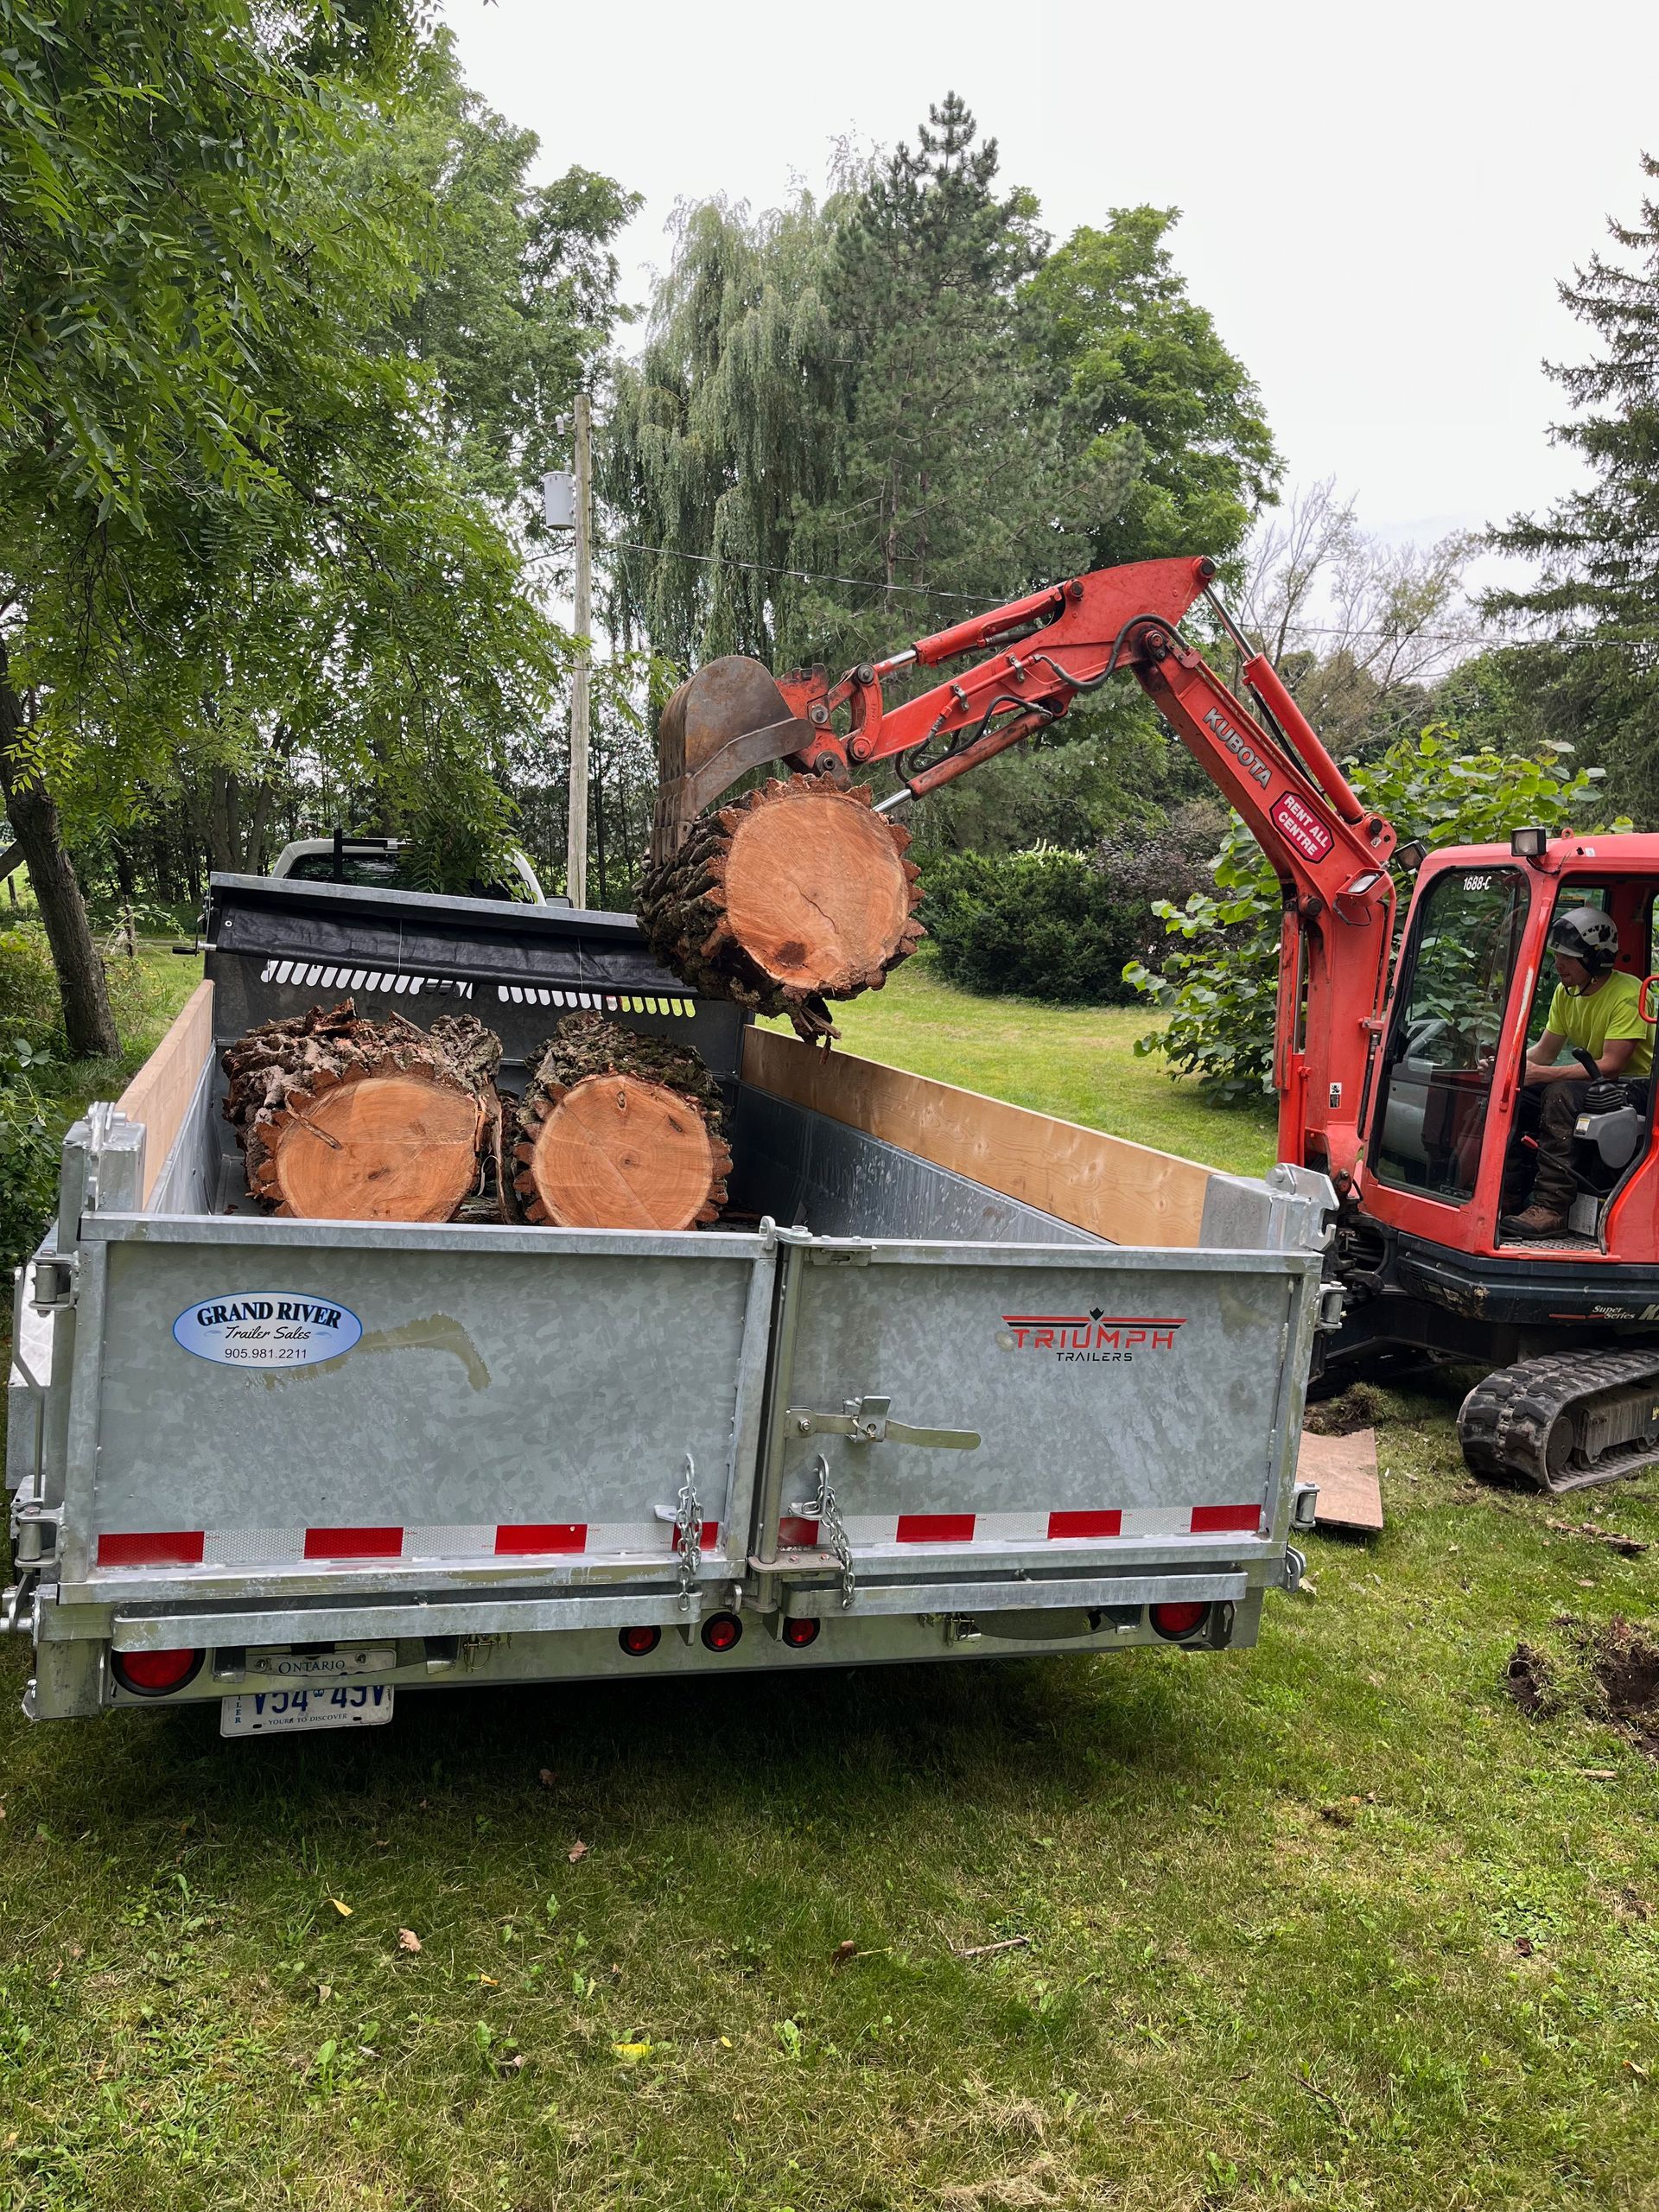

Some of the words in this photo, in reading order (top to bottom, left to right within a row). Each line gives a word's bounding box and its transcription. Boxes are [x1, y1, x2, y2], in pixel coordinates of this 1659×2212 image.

[1202, 706, 1273, 790] KUBOTA
[1283, 795, 1313, 827] RENT
[1308, 825, 1331, 849] ALL
[1278, 811, 1319, 856] CENTRE
[1463, 875, 1492, 891] 1688-C
[197, 1301, 273, 1327] GRAND
[276, 1301, 342, 1329] RIVER
[1592, 1305, 1624, 1314] Super
[1637, 1304, 1659, 1320] K
[225, 1325, 270, 1339] Trailer
[273, 1326, 311, 1339] Sales
[1012, 1325, 1175, 1350] TRIUMPH
[225, 1348, 308, 1359] 905.981.2211
[1056, 1351, 1133, 1362] TRAILERS
[278, 1660, 346, 1675] ONTARIO
[309, 1713, 347, 1722] DISCOVER
